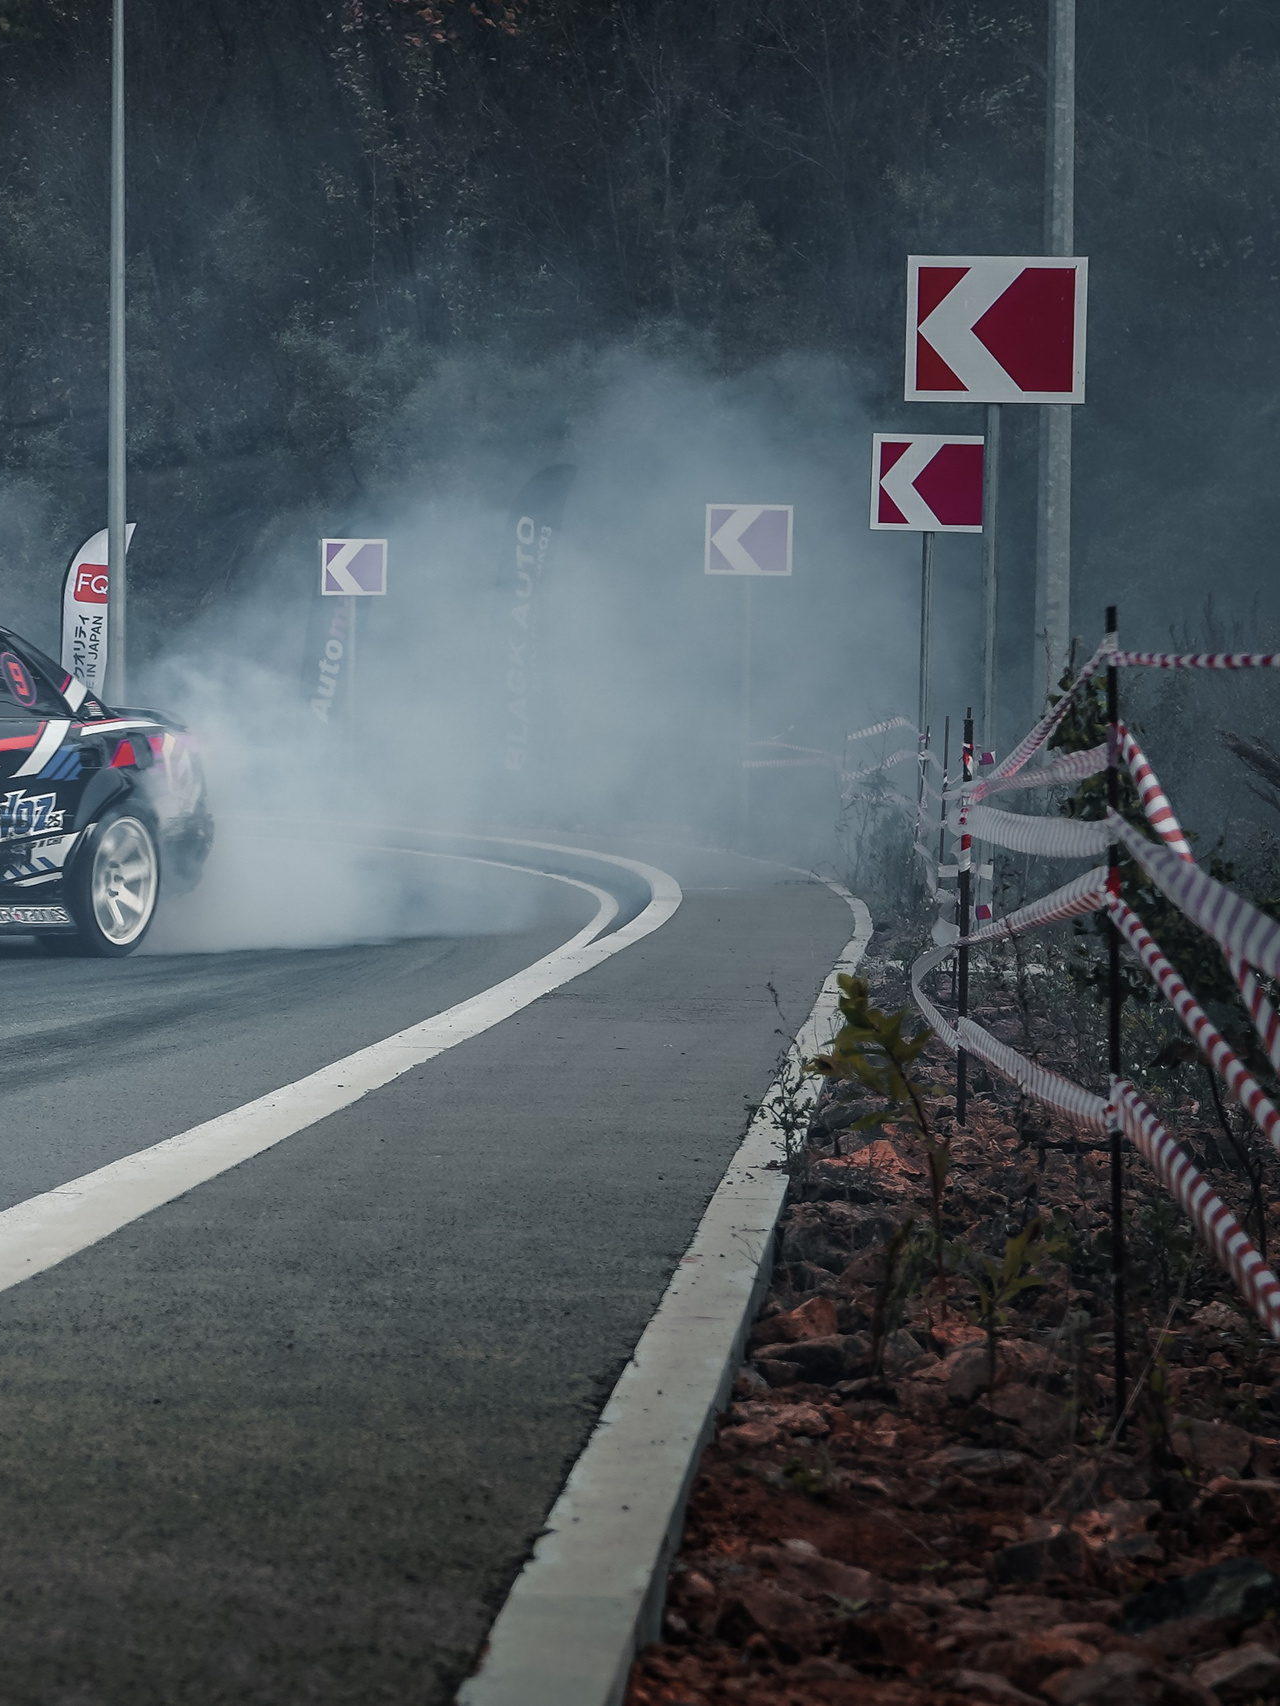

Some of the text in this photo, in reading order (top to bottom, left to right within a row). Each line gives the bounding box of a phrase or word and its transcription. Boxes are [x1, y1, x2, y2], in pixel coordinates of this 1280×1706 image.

[77, 573, 108, 594] FQ
[511, 516, 535, 629] AUTO
[88, 615, 104, 660] JAPAN
[8, 661, 29, 696] 9
[87, 664, 97, 677] IN
